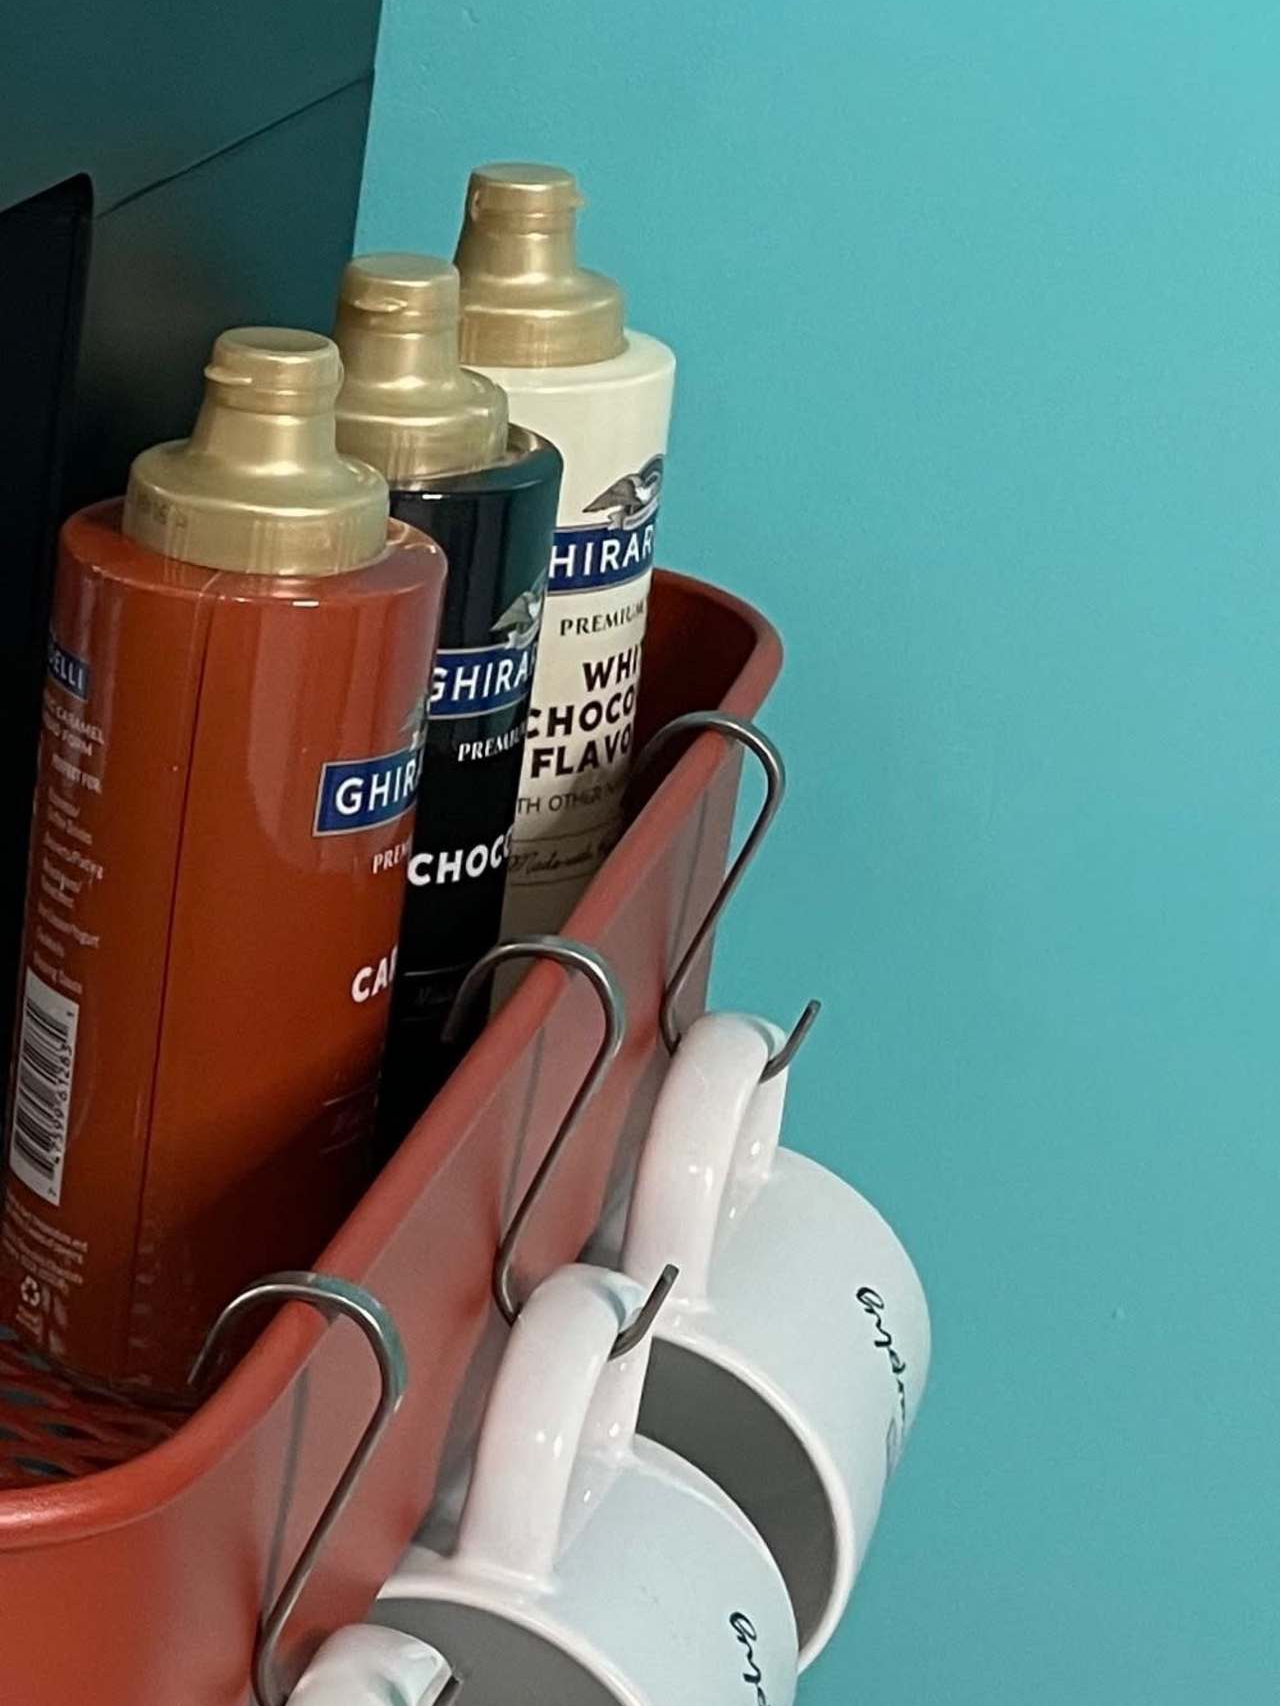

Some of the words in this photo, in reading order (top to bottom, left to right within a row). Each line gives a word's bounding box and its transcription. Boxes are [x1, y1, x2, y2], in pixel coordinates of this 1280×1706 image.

[430, 650, 530, 702] GHIRA
[581, 642, 641, 692] WHI
[526, 690, 635, 740] CHOCO
[530, 724, 634, 779] FLAVO
[334, 758, 422, 816] GHIR
